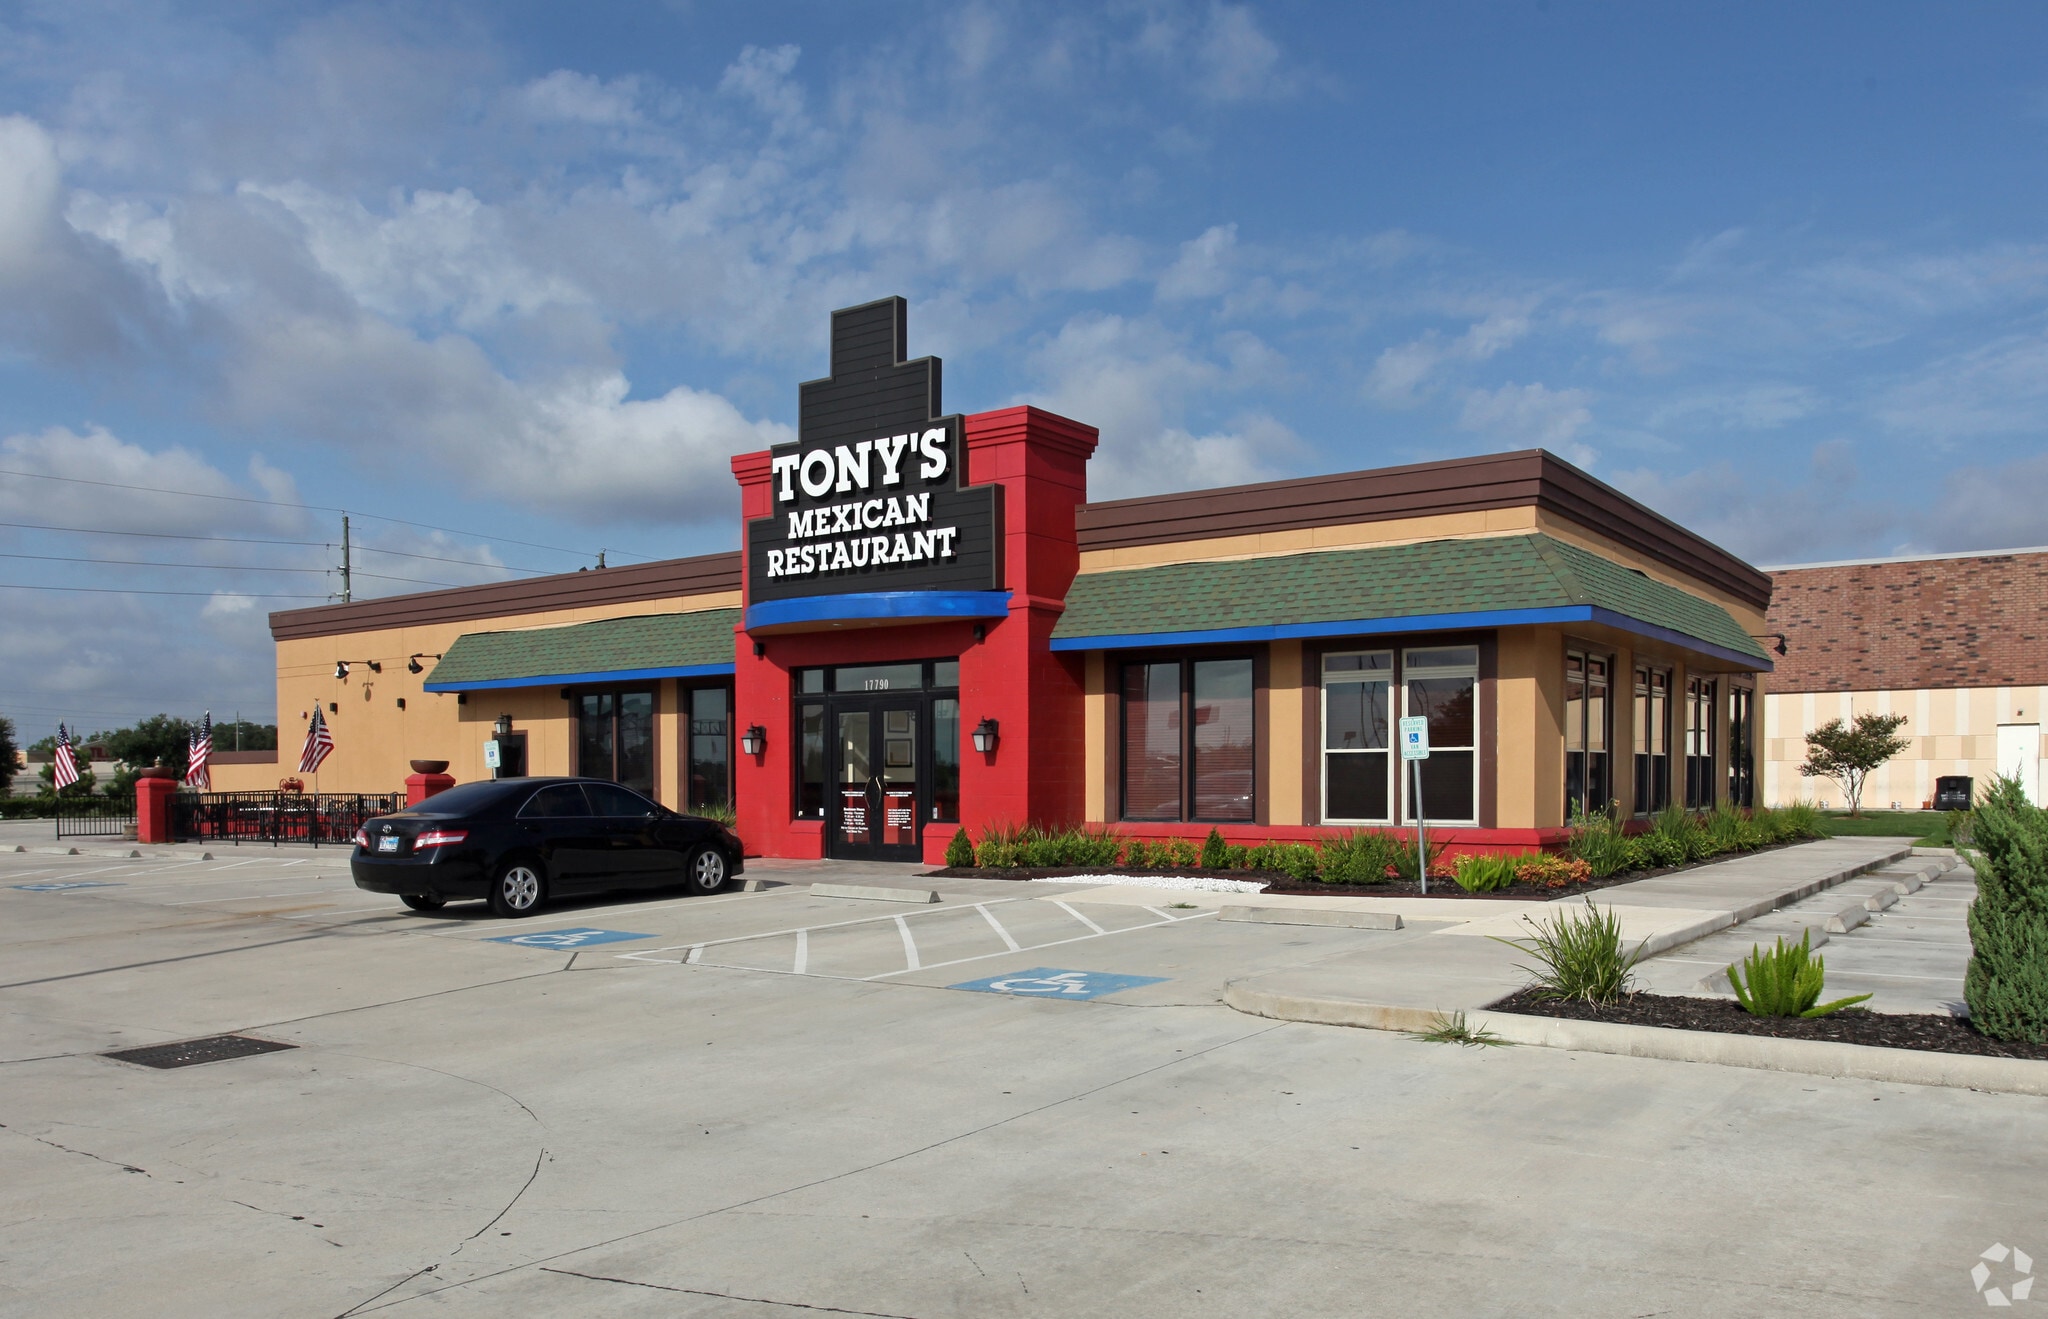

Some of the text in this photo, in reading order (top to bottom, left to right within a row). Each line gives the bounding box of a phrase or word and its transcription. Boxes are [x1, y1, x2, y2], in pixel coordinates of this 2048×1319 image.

[772, 427, 947, 502] TONY'S
[788, 492, 930, 540] MEXICAN
[767, 526, 957, 577] RESTAURANT
[864, 679, 889, 691] 17790
